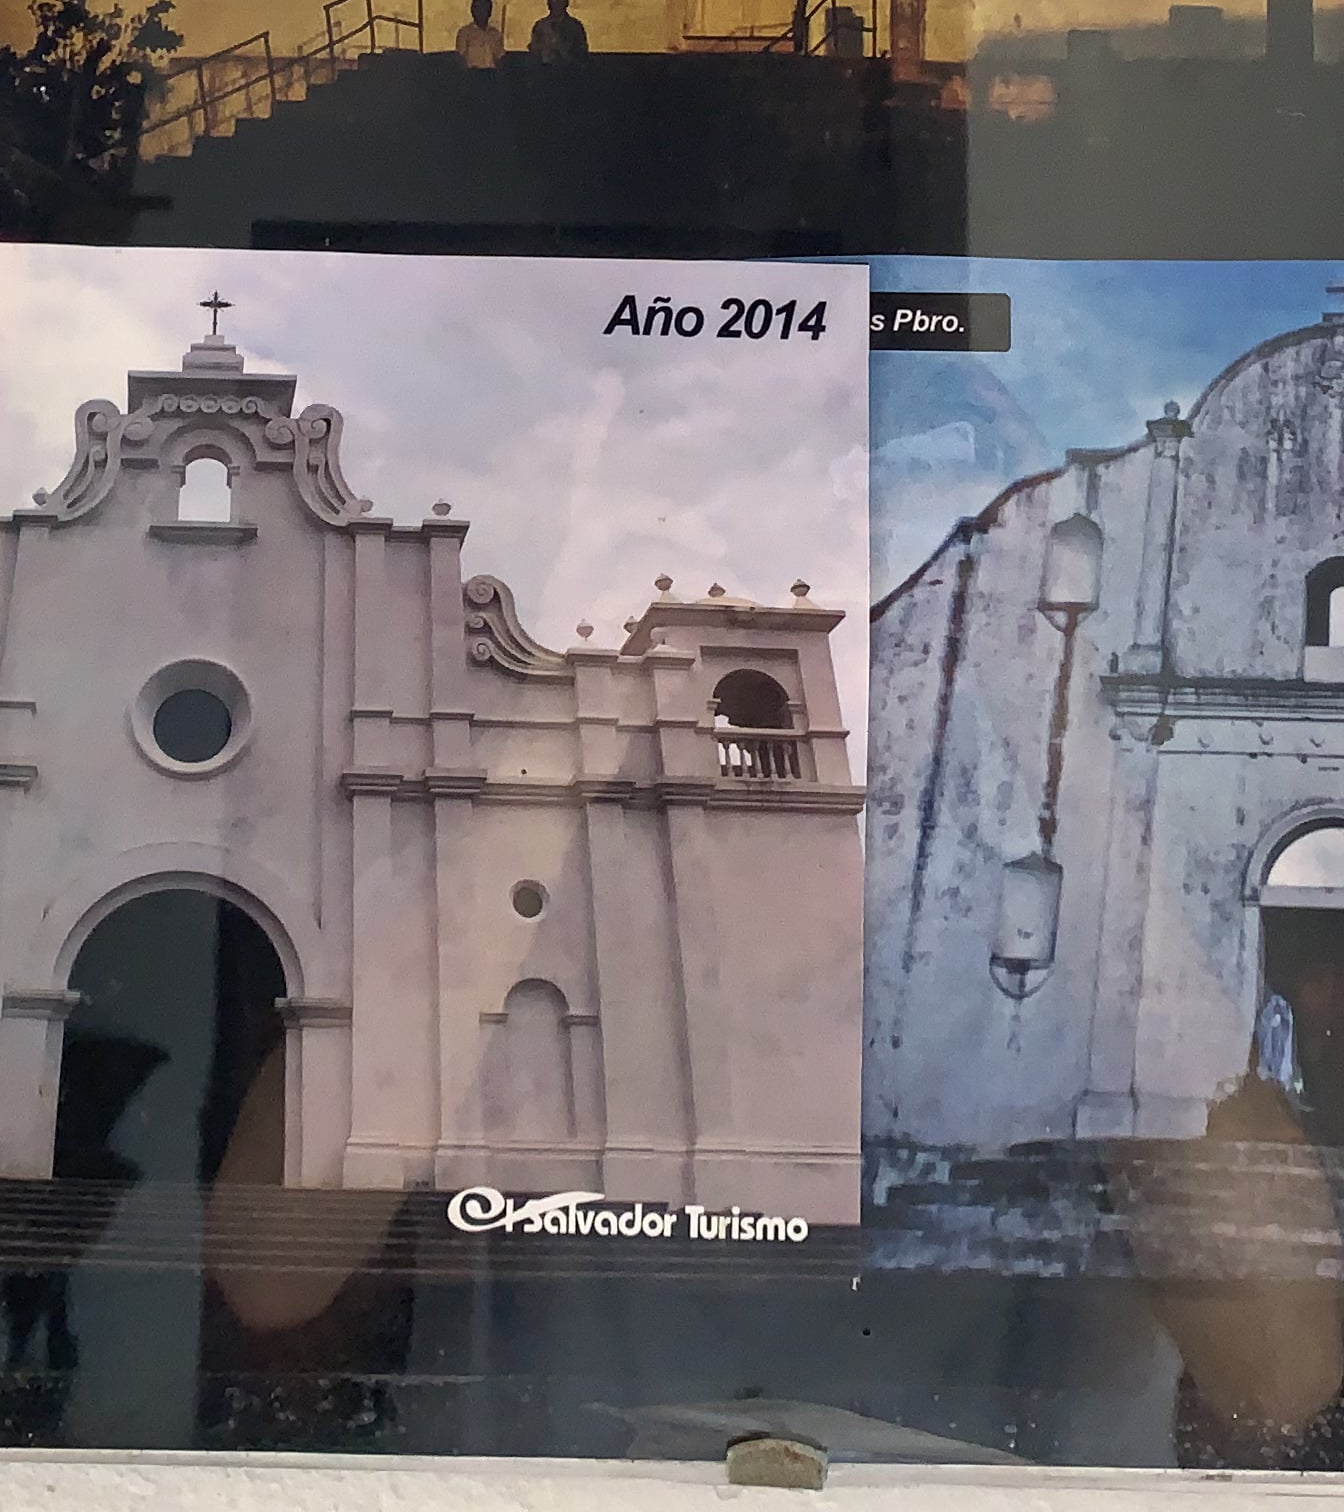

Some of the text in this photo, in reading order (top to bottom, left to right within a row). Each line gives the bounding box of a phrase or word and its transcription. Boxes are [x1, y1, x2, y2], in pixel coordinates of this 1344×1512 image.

[602, 294, 828, 341] Año 2014
[893, 309, 965, 332] Pbro.
[684, 1205, 809, 1243] Turismo
